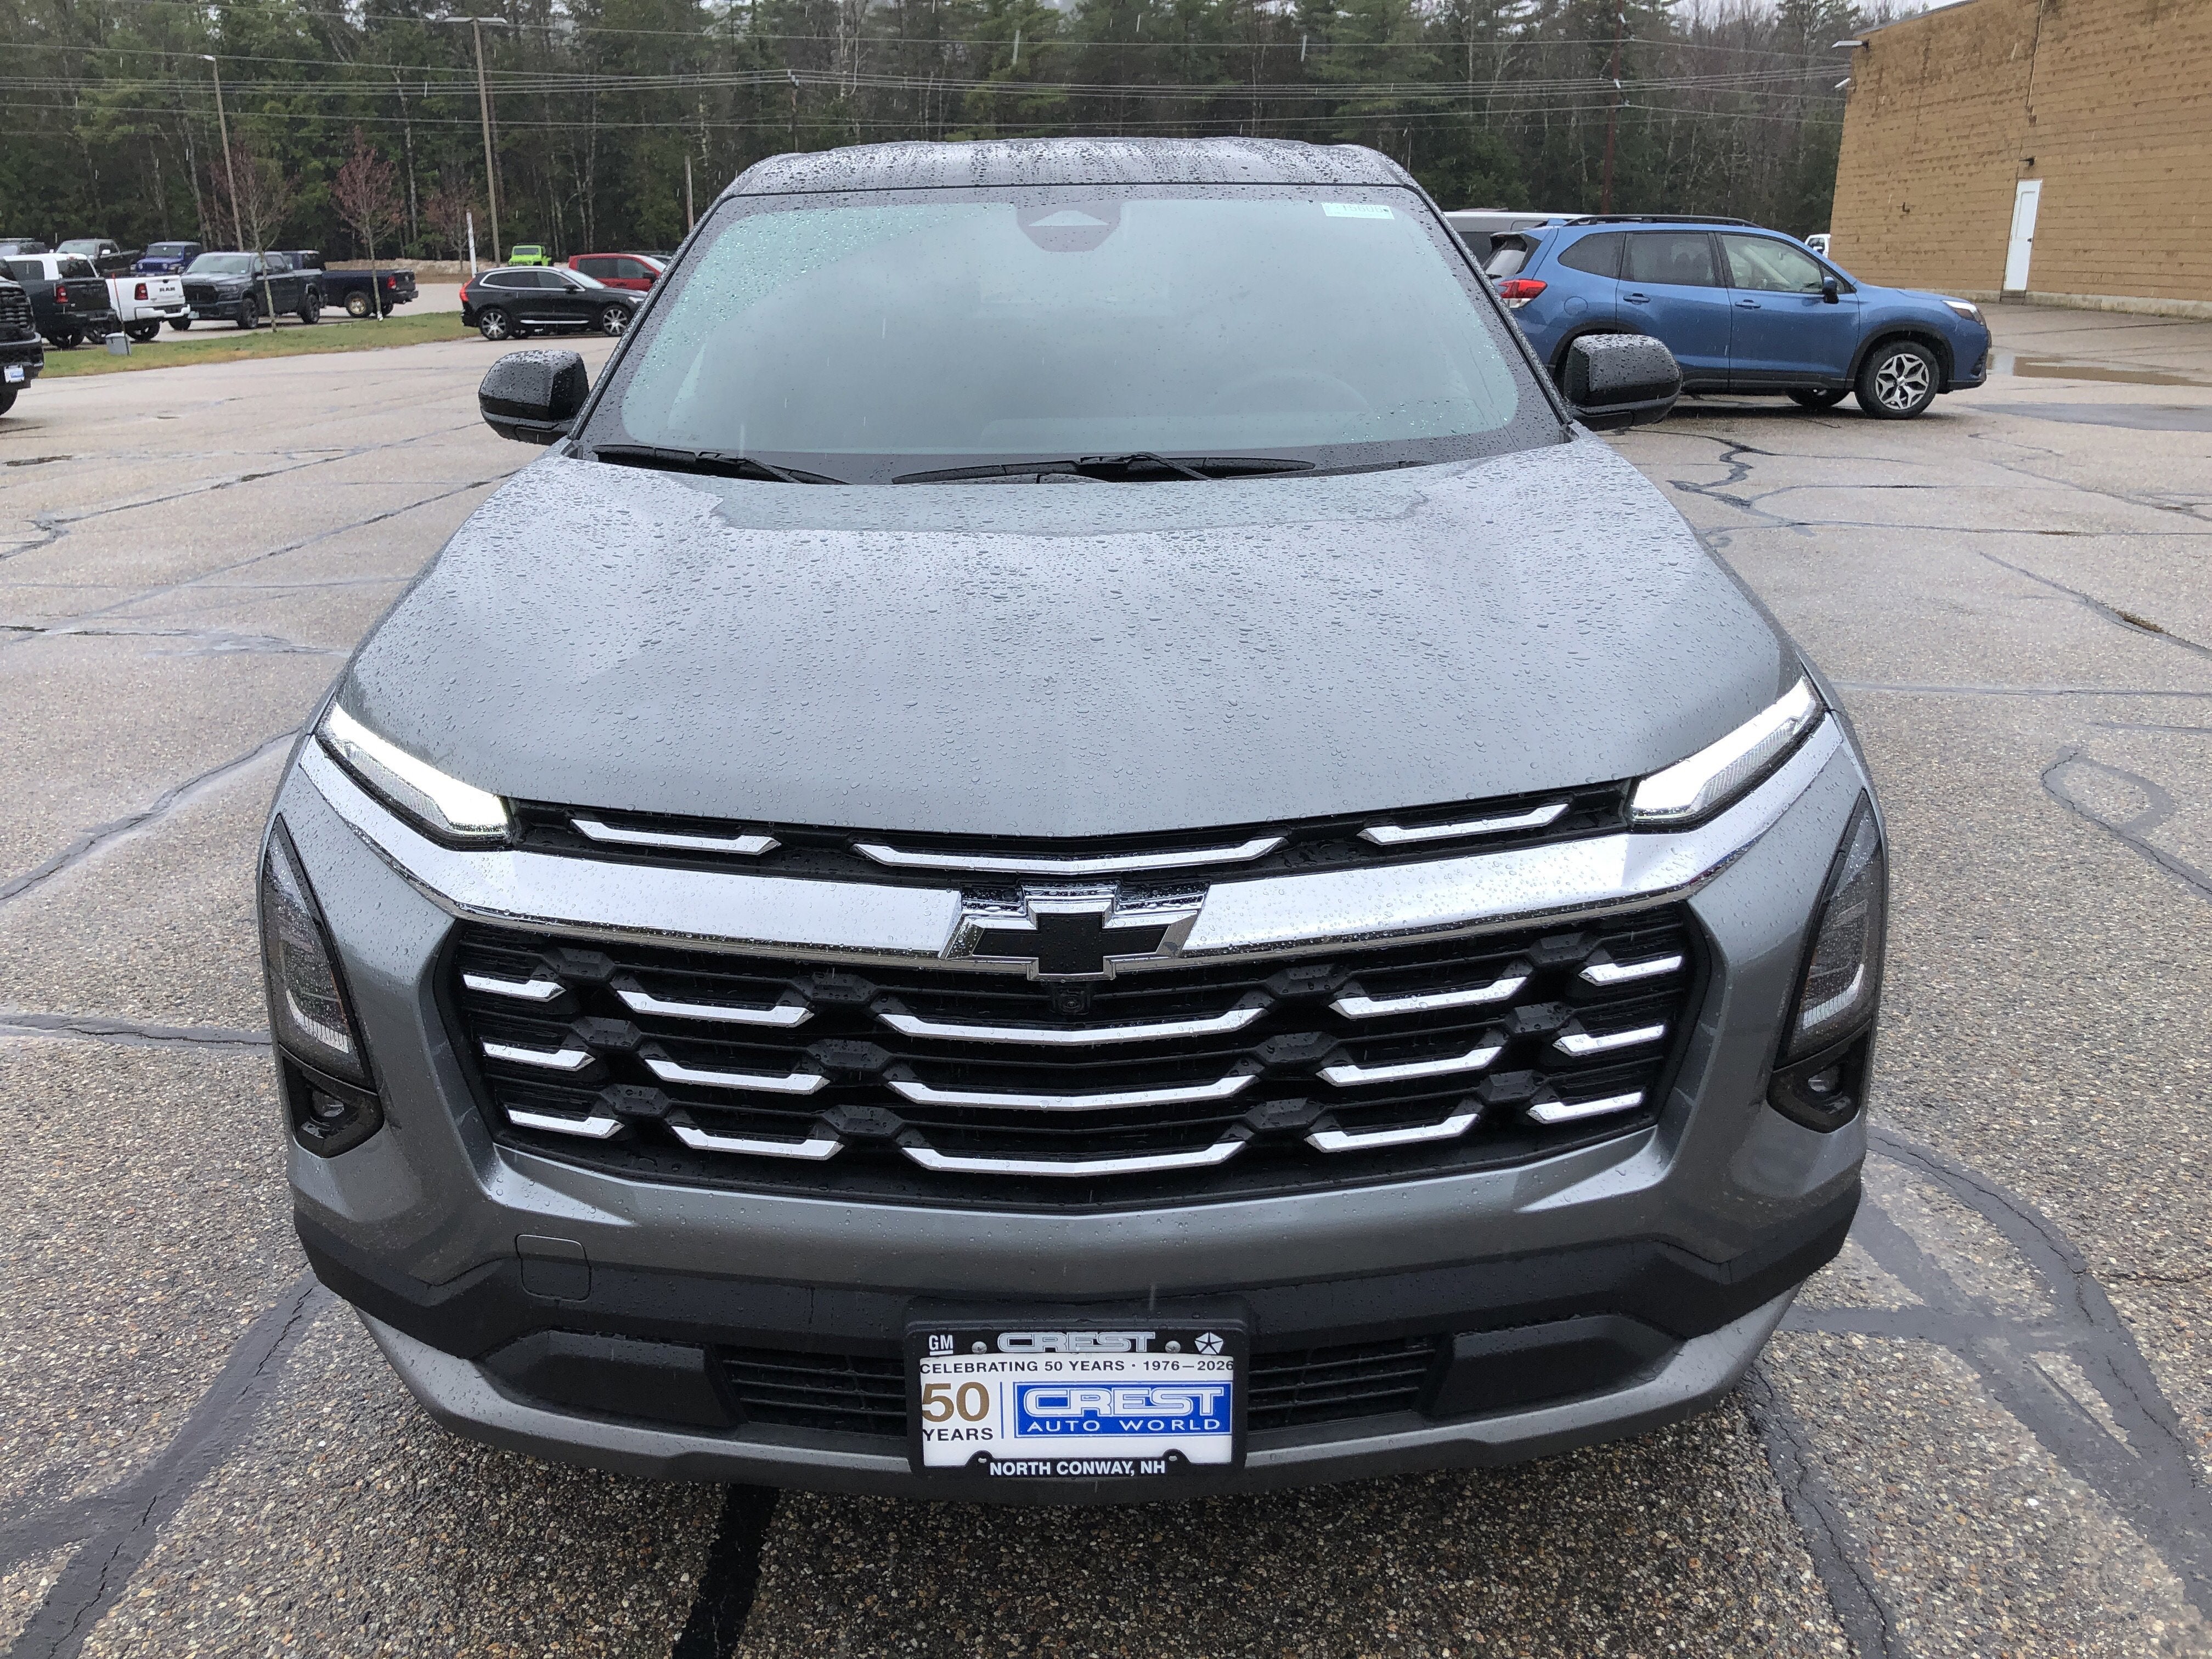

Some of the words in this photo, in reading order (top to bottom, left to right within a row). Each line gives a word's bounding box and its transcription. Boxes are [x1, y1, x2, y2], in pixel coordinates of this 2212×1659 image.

[928, 1334, 953, 1350] GM
[997, 1331, 1155, 1353] CREST
[920, 1361, 1038, 1374] CELEBRATING
[1044, 1361, 1063, 1372] 50
[1068, 1360, 1125, 1372] YEARS
[922, 1381, 990, 1423] 50
[1023, 1387, 1224, 1418] CREST
[1027, 1420, 1100, 1432] AUTO
[1119, 1419, 1220, 1431] WORLD
[923, 1427, 993, 1441] YEARS
[990, 1462, 1051, 1476] NORTH
[1057, 1460, 1135, 1476] CONWAY,
[1141, 1460, 1165, 1474] NH
